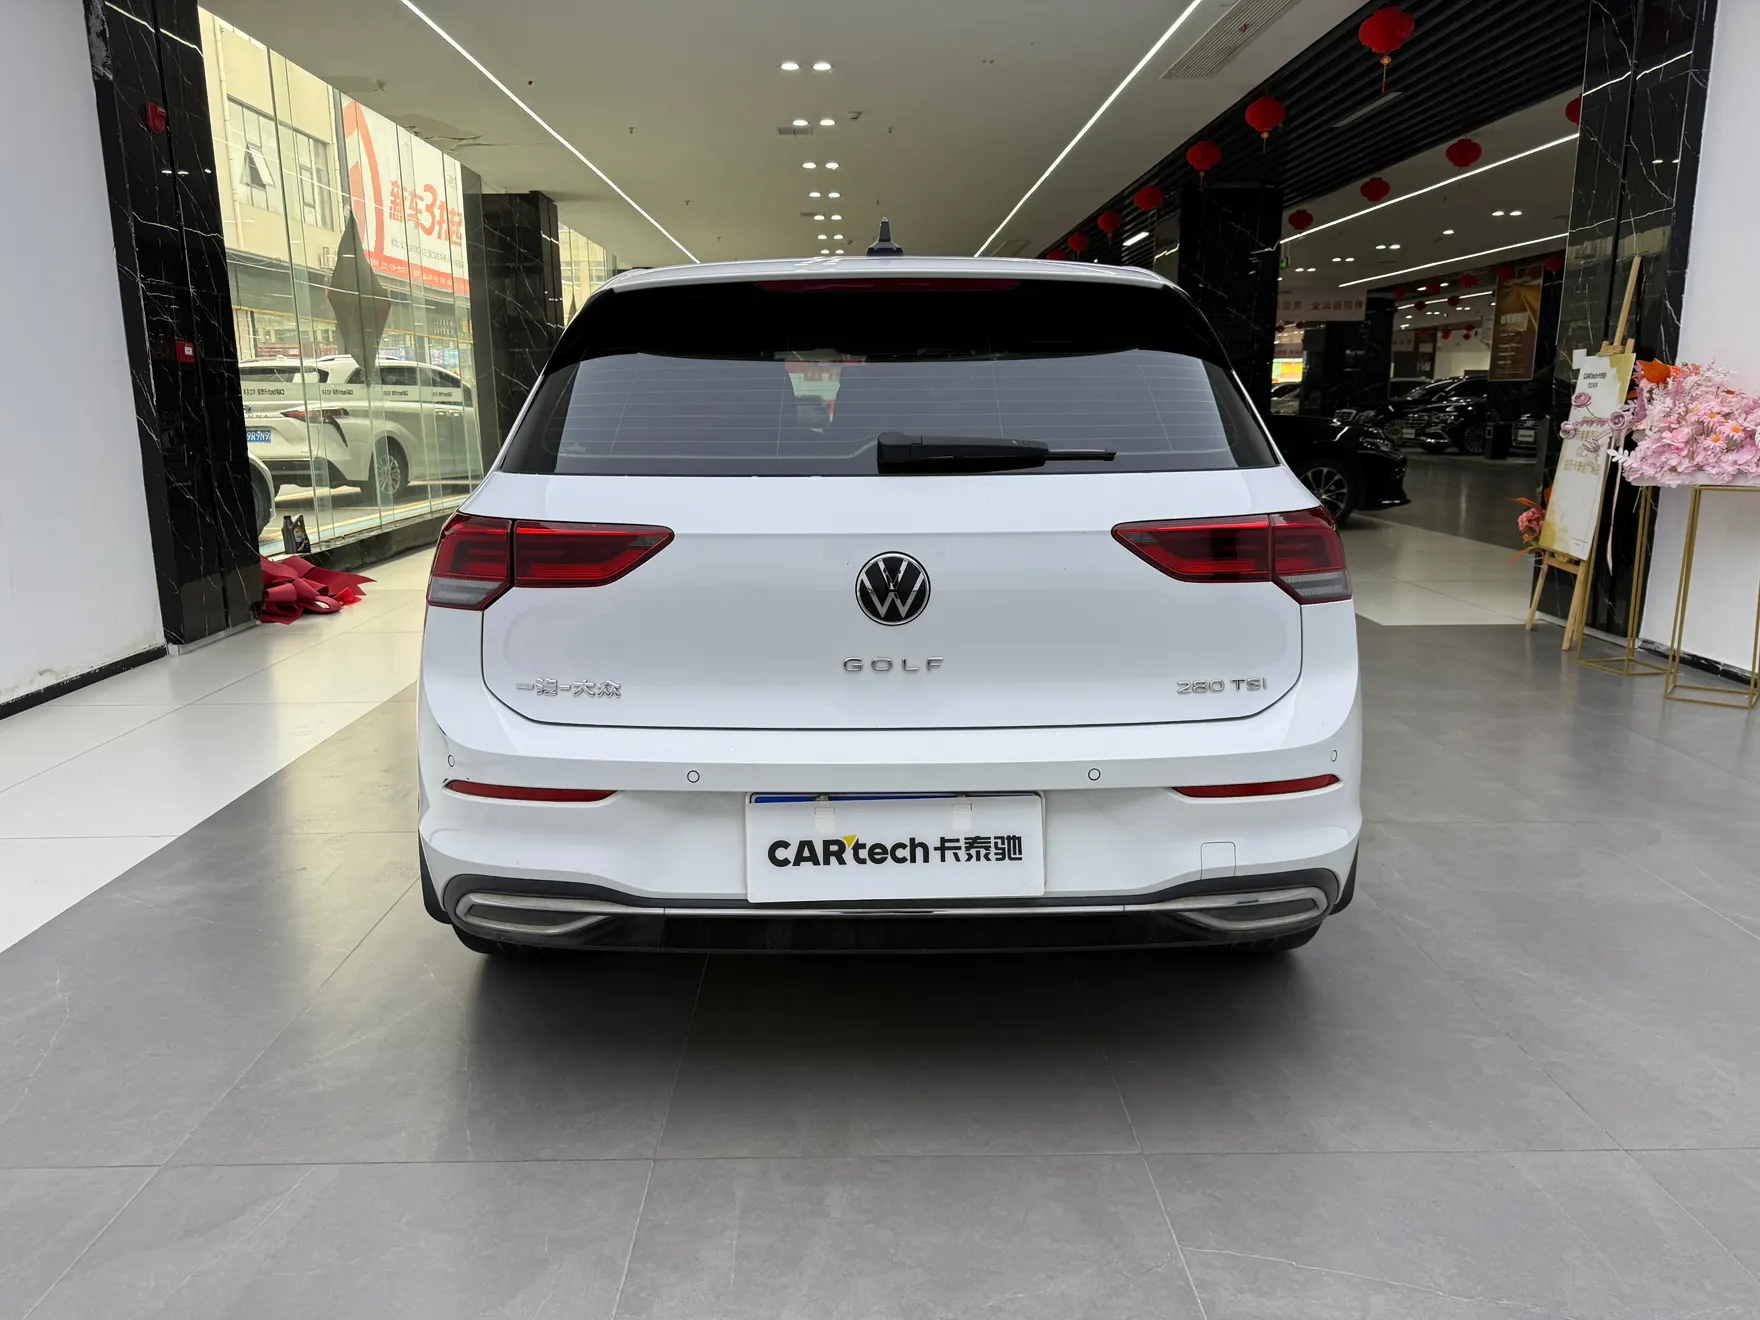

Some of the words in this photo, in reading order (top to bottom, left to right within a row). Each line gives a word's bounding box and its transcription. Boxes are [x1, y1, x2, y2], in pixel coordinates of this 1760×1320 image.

[842, 657, 944, 672] GOLF
[1176, 680, 1225, 695] 280
[1230, 677, 1268, 692] TSI
